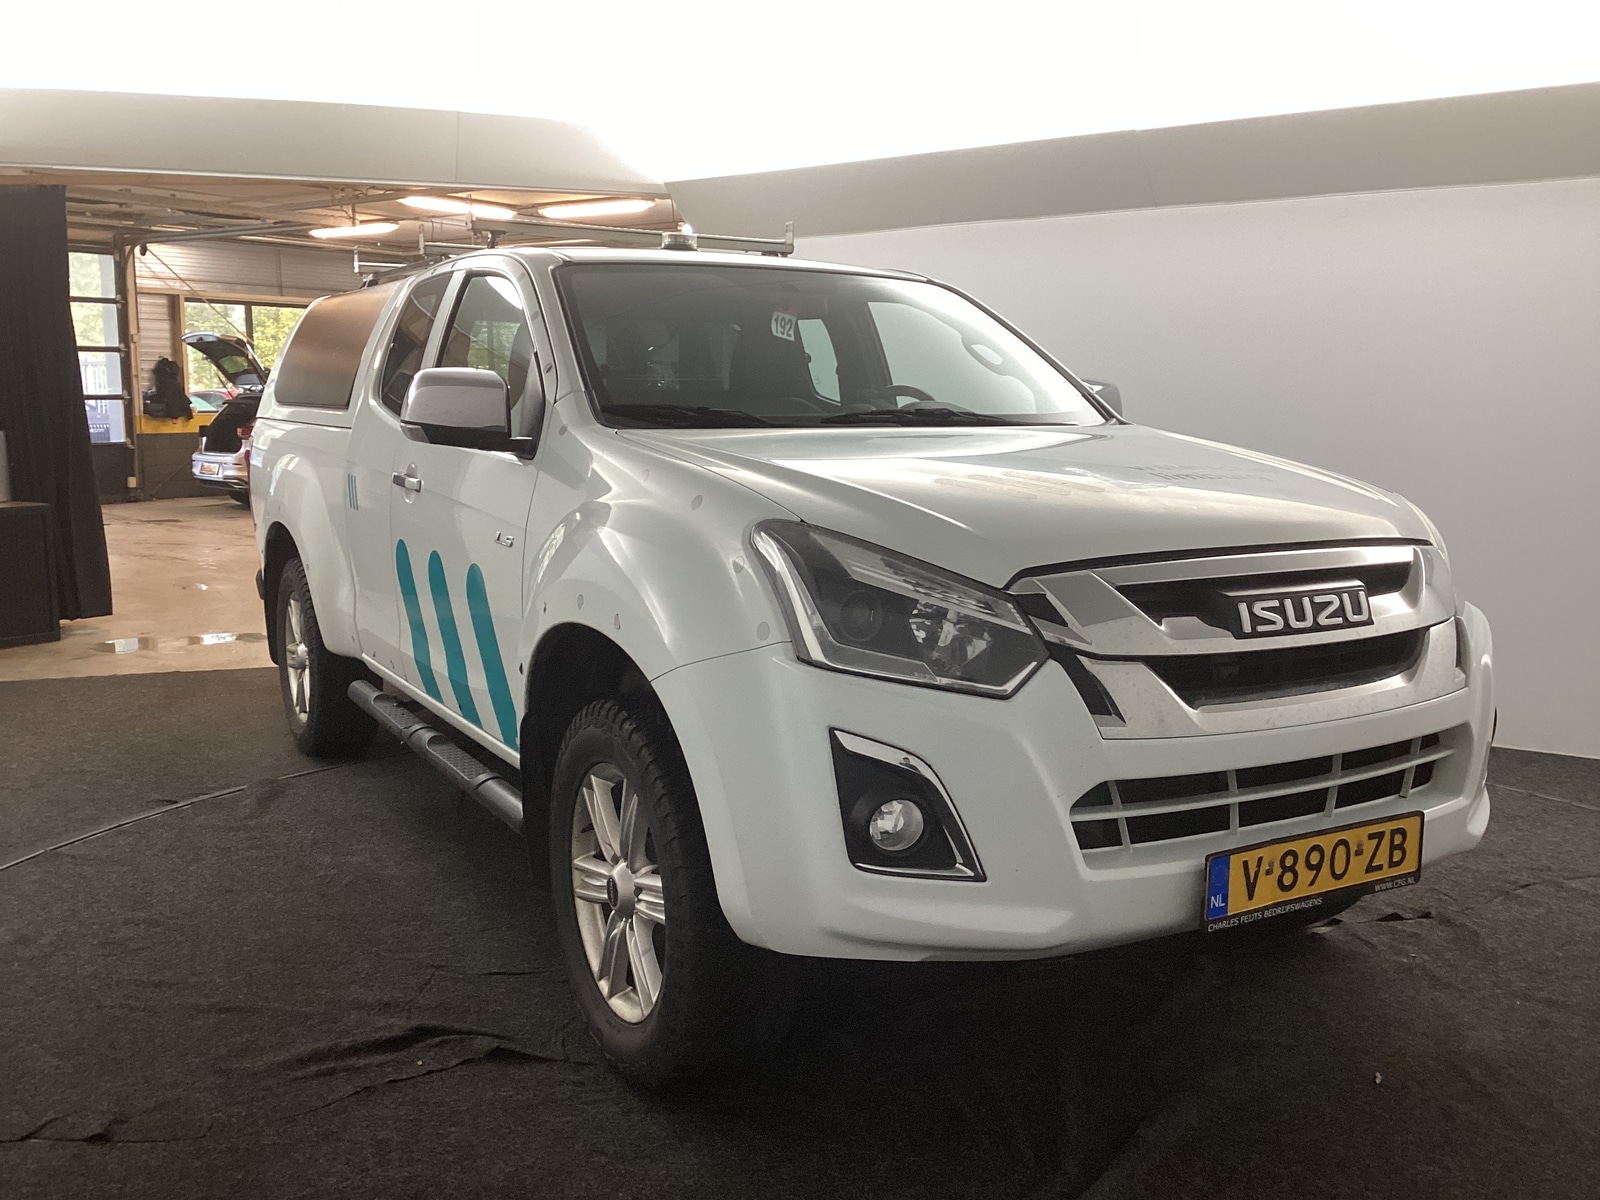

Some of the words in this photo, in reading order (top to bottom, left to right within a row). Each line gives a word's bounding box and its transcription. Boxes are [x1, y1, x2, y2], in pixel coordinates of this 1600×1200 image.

[774, 315, 793, 338] 192
[495, 531, 514, 547] LS
[1238, 591, 1369, 633] ISUZU
[1242, 827, 1407, 901] V-890-ZB
[1210, 894, 1225, 909] NL
[1207, 917, 1239, 932] CHARLES
